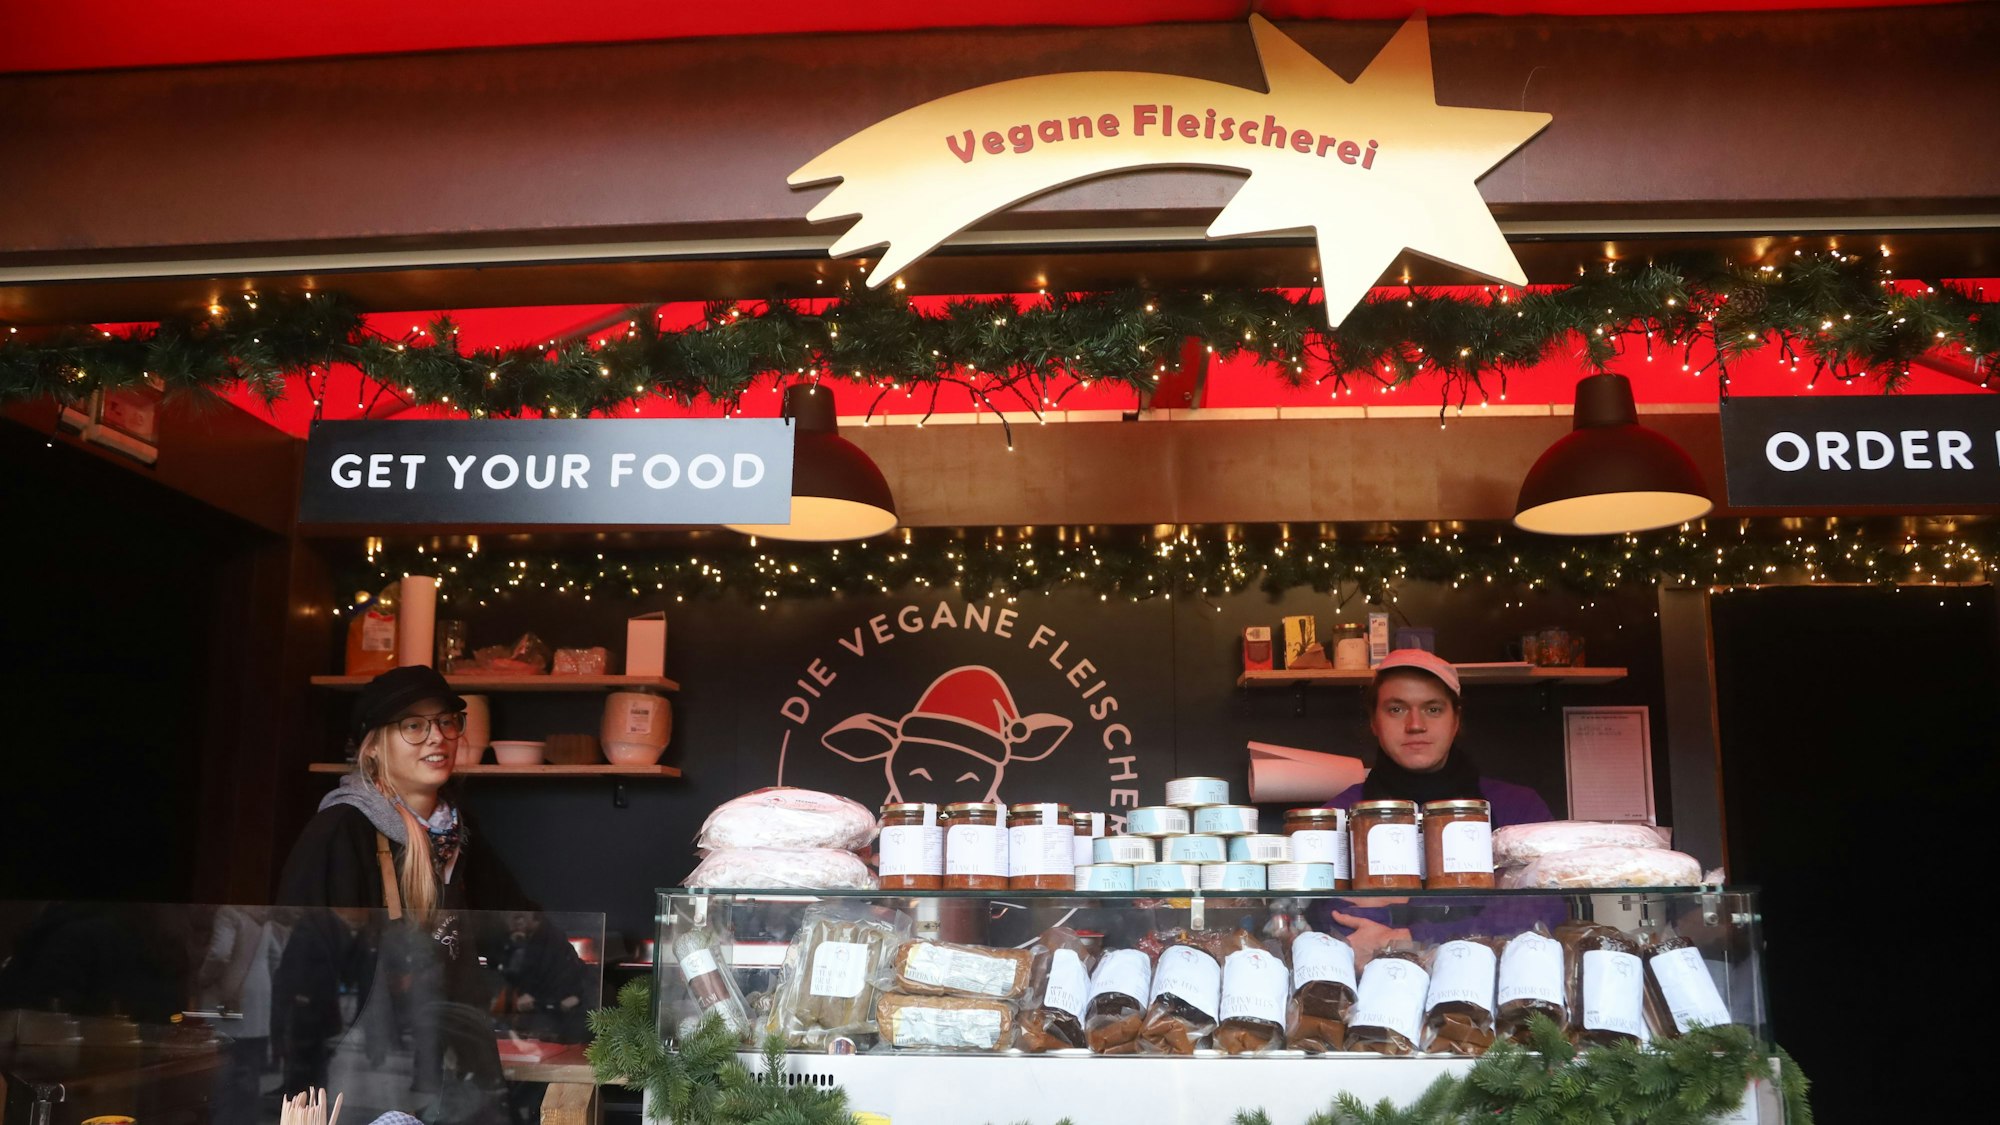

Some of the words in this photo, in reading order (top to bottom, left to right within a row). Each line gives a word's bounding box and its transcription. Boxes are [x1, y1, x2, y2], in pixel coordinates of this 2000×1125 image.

[946, 112, 1120, 164] Vegane
[1133, 104, 1380, 170] Fleischerei
[330, 453, 426, 489] GET
[446, 453, 591, 490] YOUR
[610, 453, 765, 489] FOOD
[1765, 430, 1974, 472] ORDER
[780, 658, 837, 725] DIE
[838, 601, 1019, 657] VEGANE
